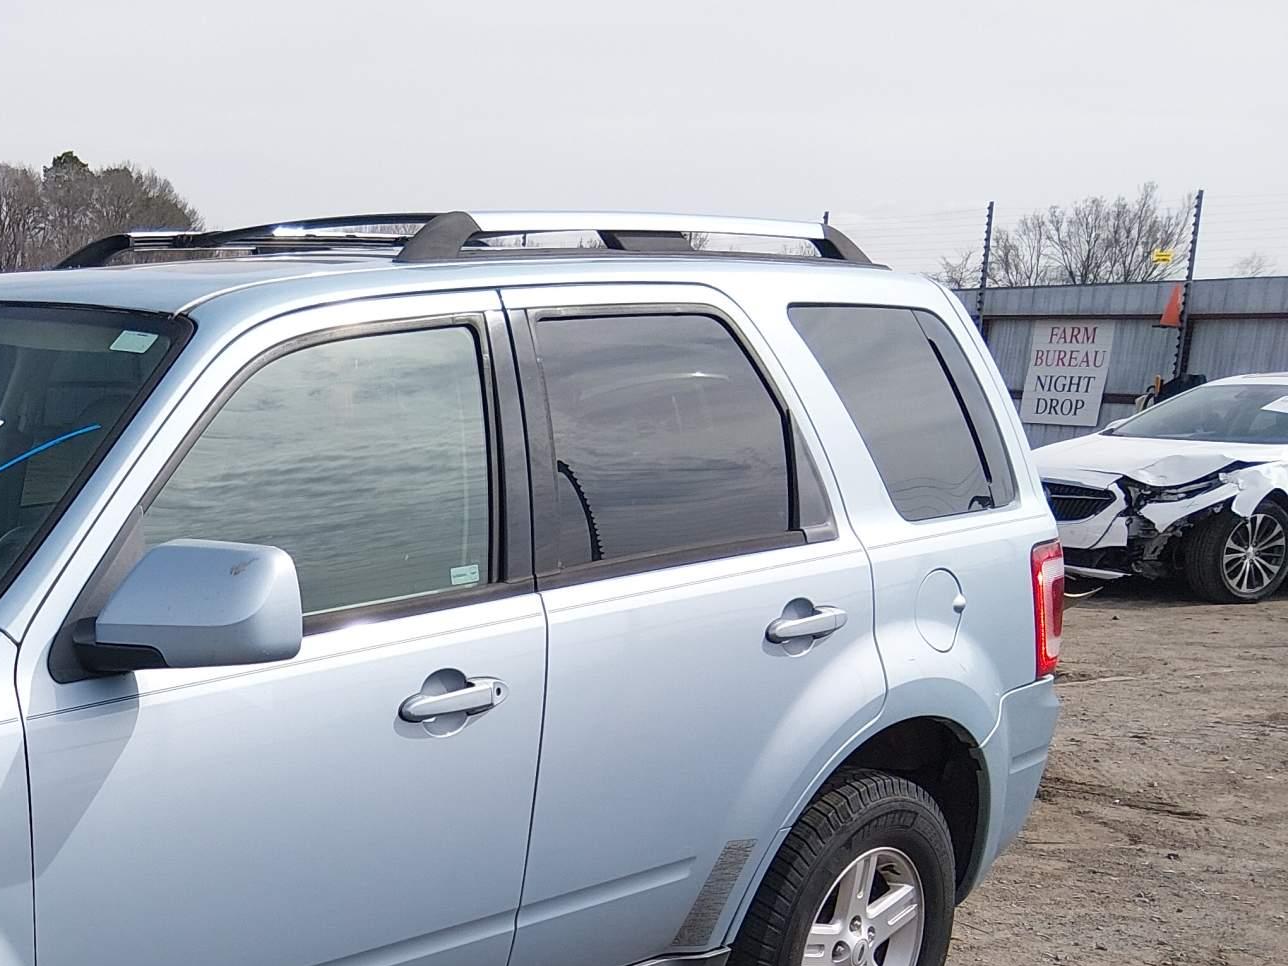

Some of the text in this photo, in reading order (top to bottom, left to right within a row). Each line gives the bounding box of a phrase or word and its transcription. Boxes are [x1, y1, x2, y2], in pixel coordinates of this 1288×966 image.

[1048, 326, 1098, 344] FARM
[1034, 349, 1106, 368] BUREAU
[1034, 375, 1096, 393] NIGHT
[1034, 397, 1085, 416] DROP
